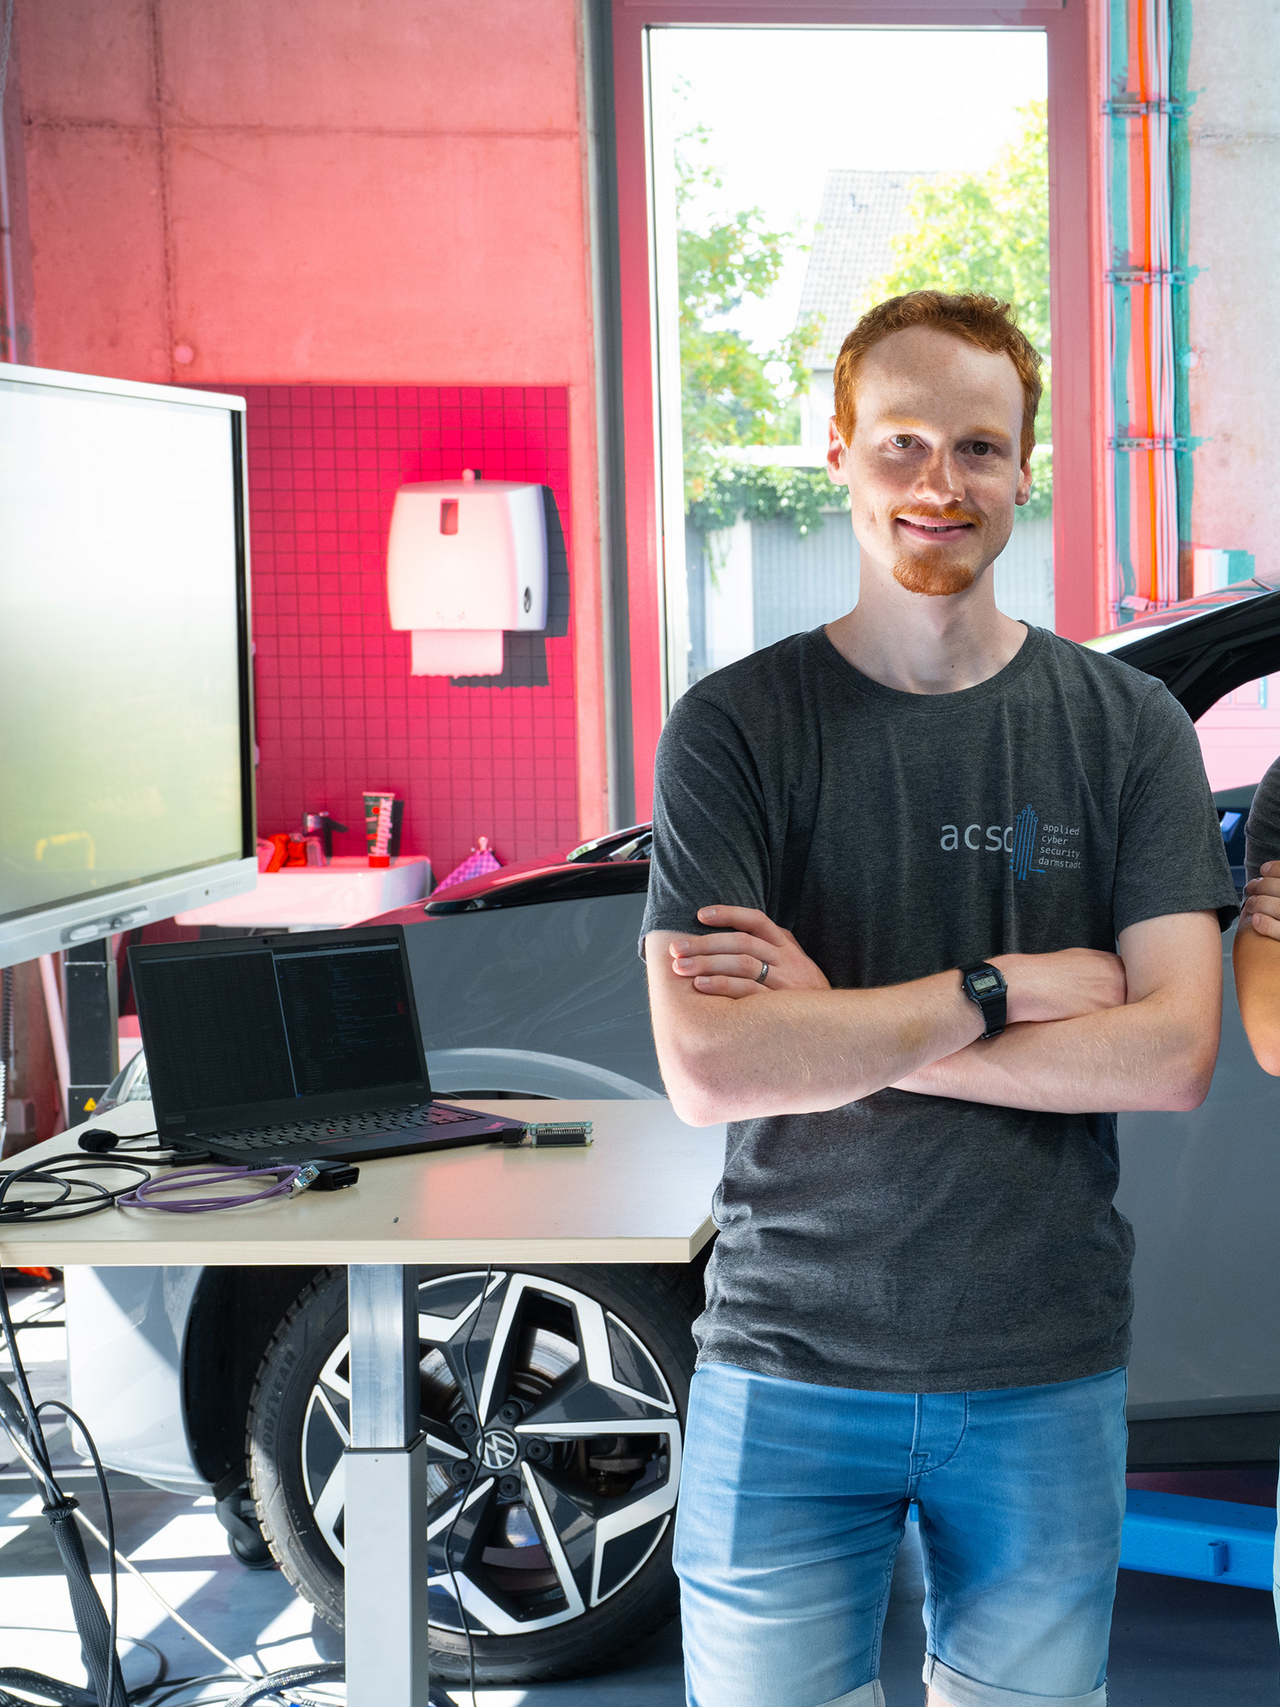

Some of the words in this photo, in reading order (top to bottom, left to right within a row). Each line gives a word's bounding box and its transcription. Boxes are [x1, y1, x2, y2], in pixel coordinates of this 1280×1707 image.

[1042, 823, 1080, 836] applied
[1041, 834, 1069, 846] cyber
[1039, 846, 1081, 860] security
[1038, 857, 1081, 869] darmstadt
